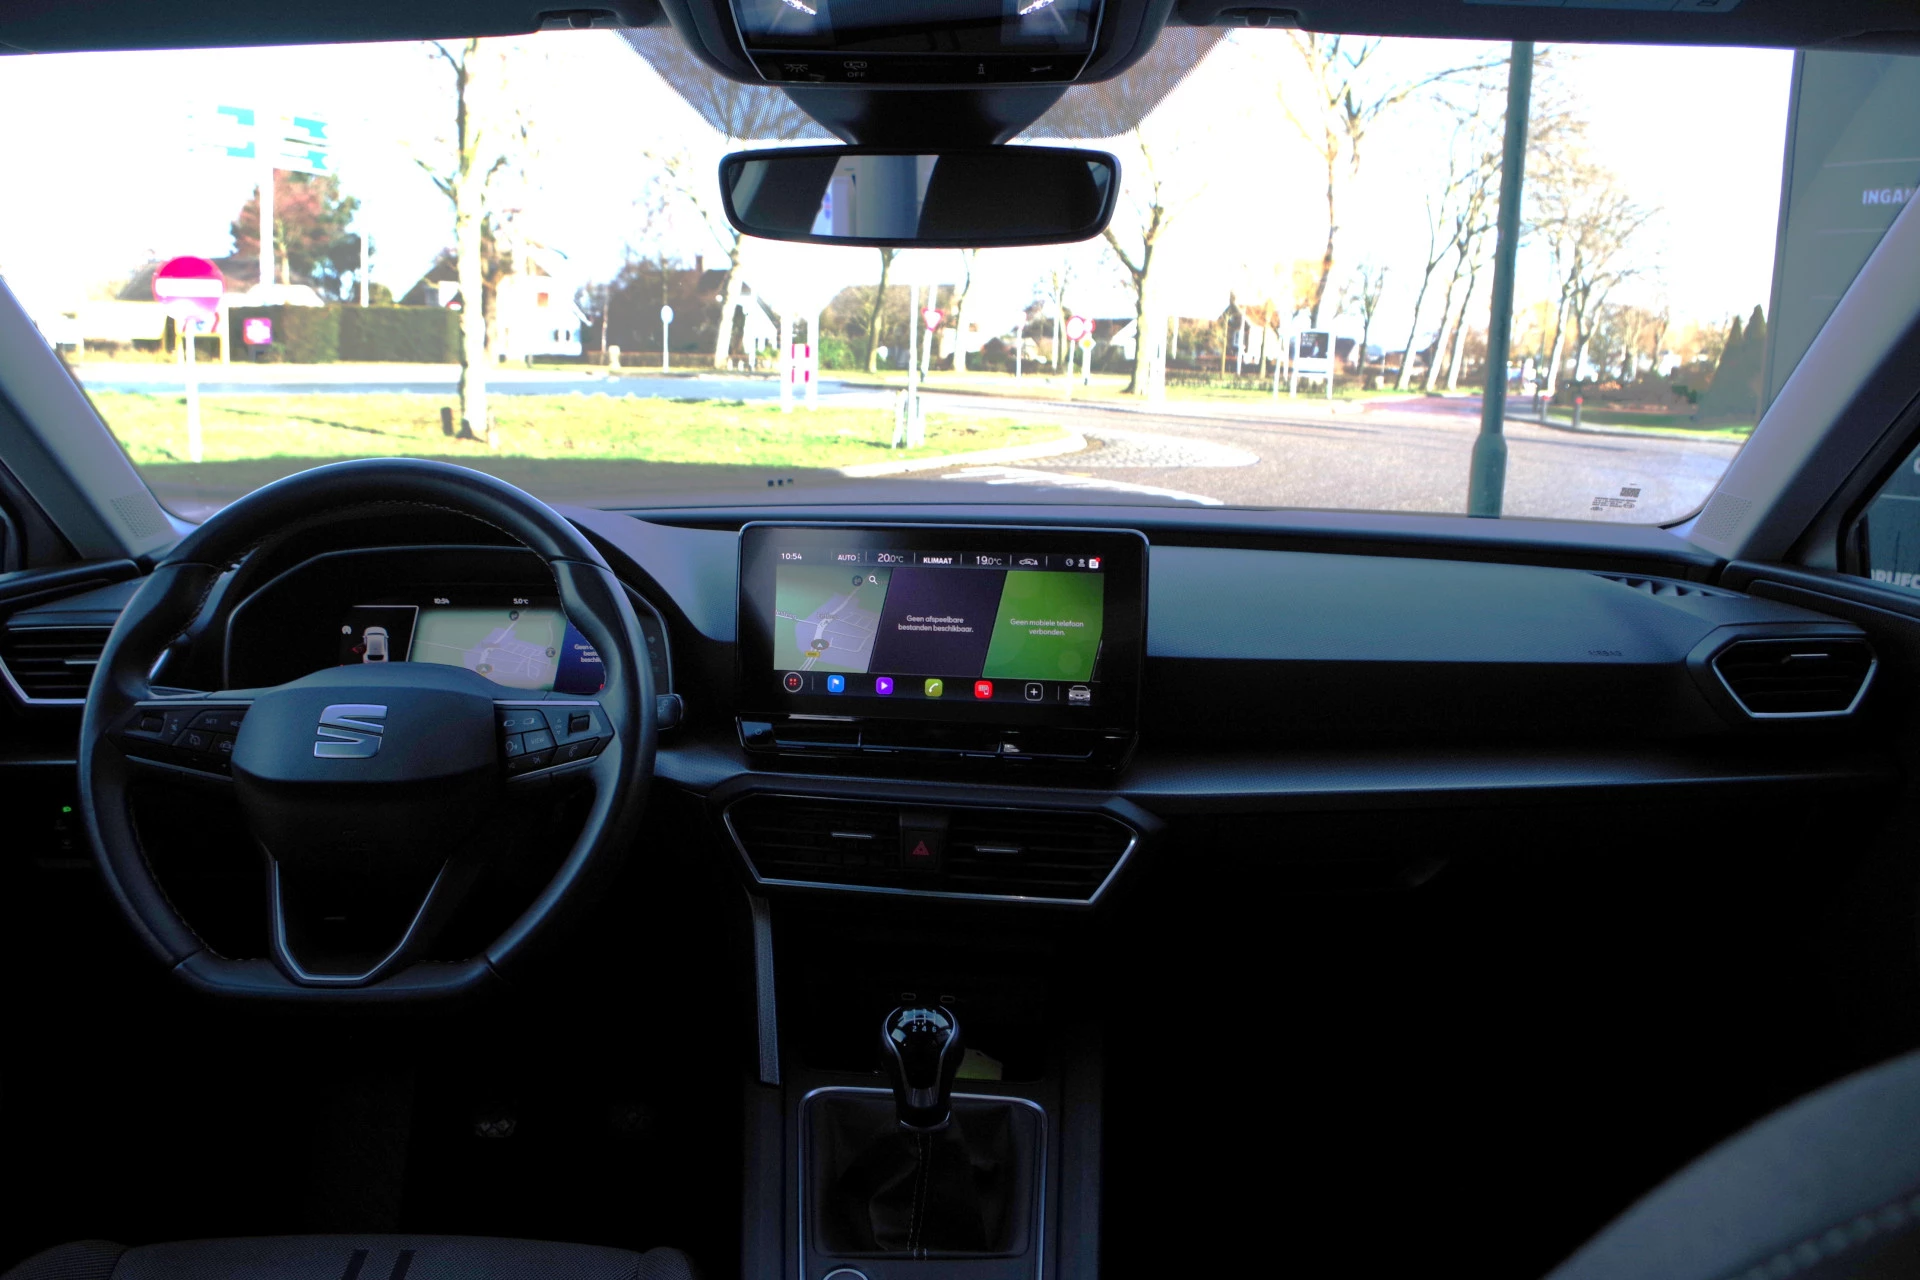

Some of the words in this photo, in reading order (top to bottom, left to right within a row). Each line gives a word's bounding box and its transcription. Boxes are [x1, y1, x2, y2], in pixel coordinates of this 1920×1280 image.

[780, 552, 803, 561] 10:54
[837, 553, 857, 561] AUTO
[923, 556, 953, 565] KLIMAAT
[906, 614, 925, 622] Geen
[925, 615, 964, 624] afspeelbare
[1010, 618, 1028, 626] Geen
[1029, 618, 1055, 627] mobiele
[1056, 619, 1084, 627] telefoon
[897, 623, 932, 632] bestanden
[933, 624, 974, 633] beschikbaar.
[530, 736, 545, 745] VIEW
